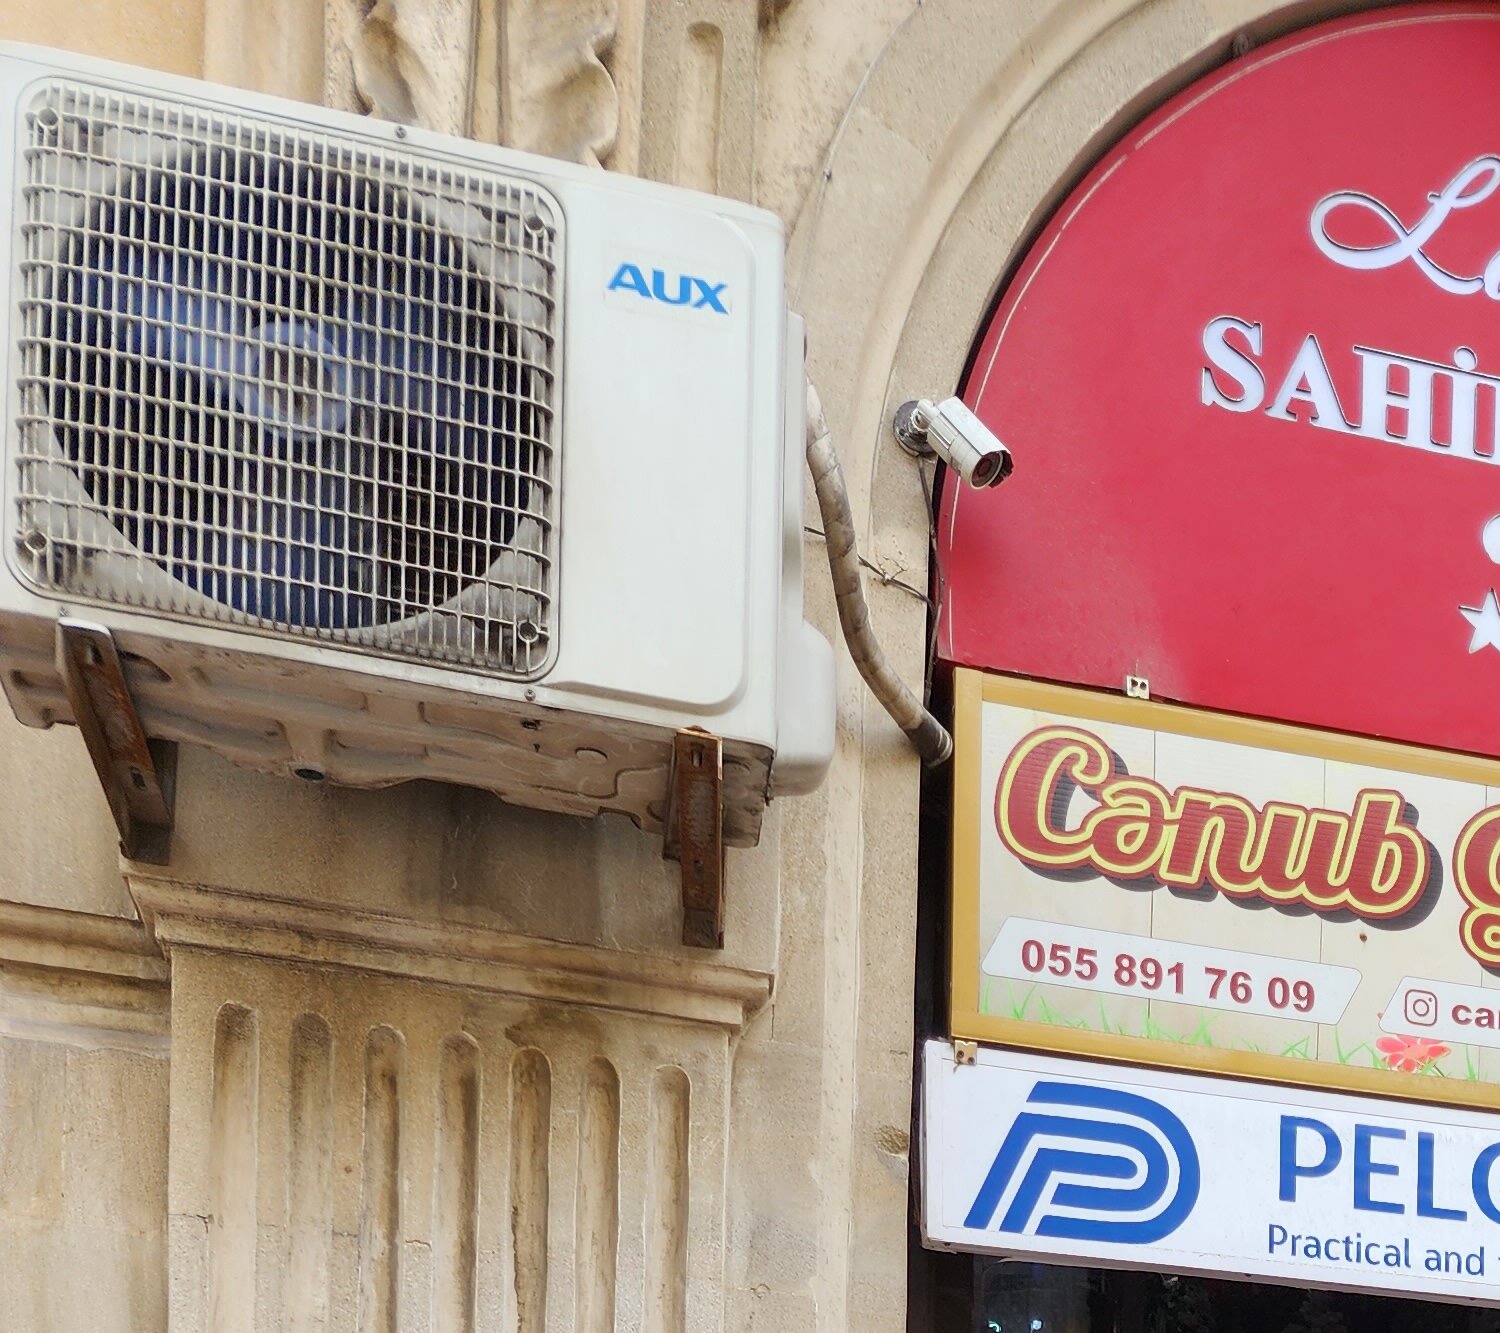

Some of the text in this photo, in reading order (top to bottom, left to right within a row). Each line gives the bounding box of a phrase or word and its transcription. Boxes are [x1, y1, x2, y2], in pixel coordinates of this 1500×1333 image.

[607, 261, 730, 316] AUX
[1021, 939, 1316, 1013] 055 891 76 09
[1267, 1223, 1412, 1270] Practical
[1423, 1245, 1486, 1276] and
